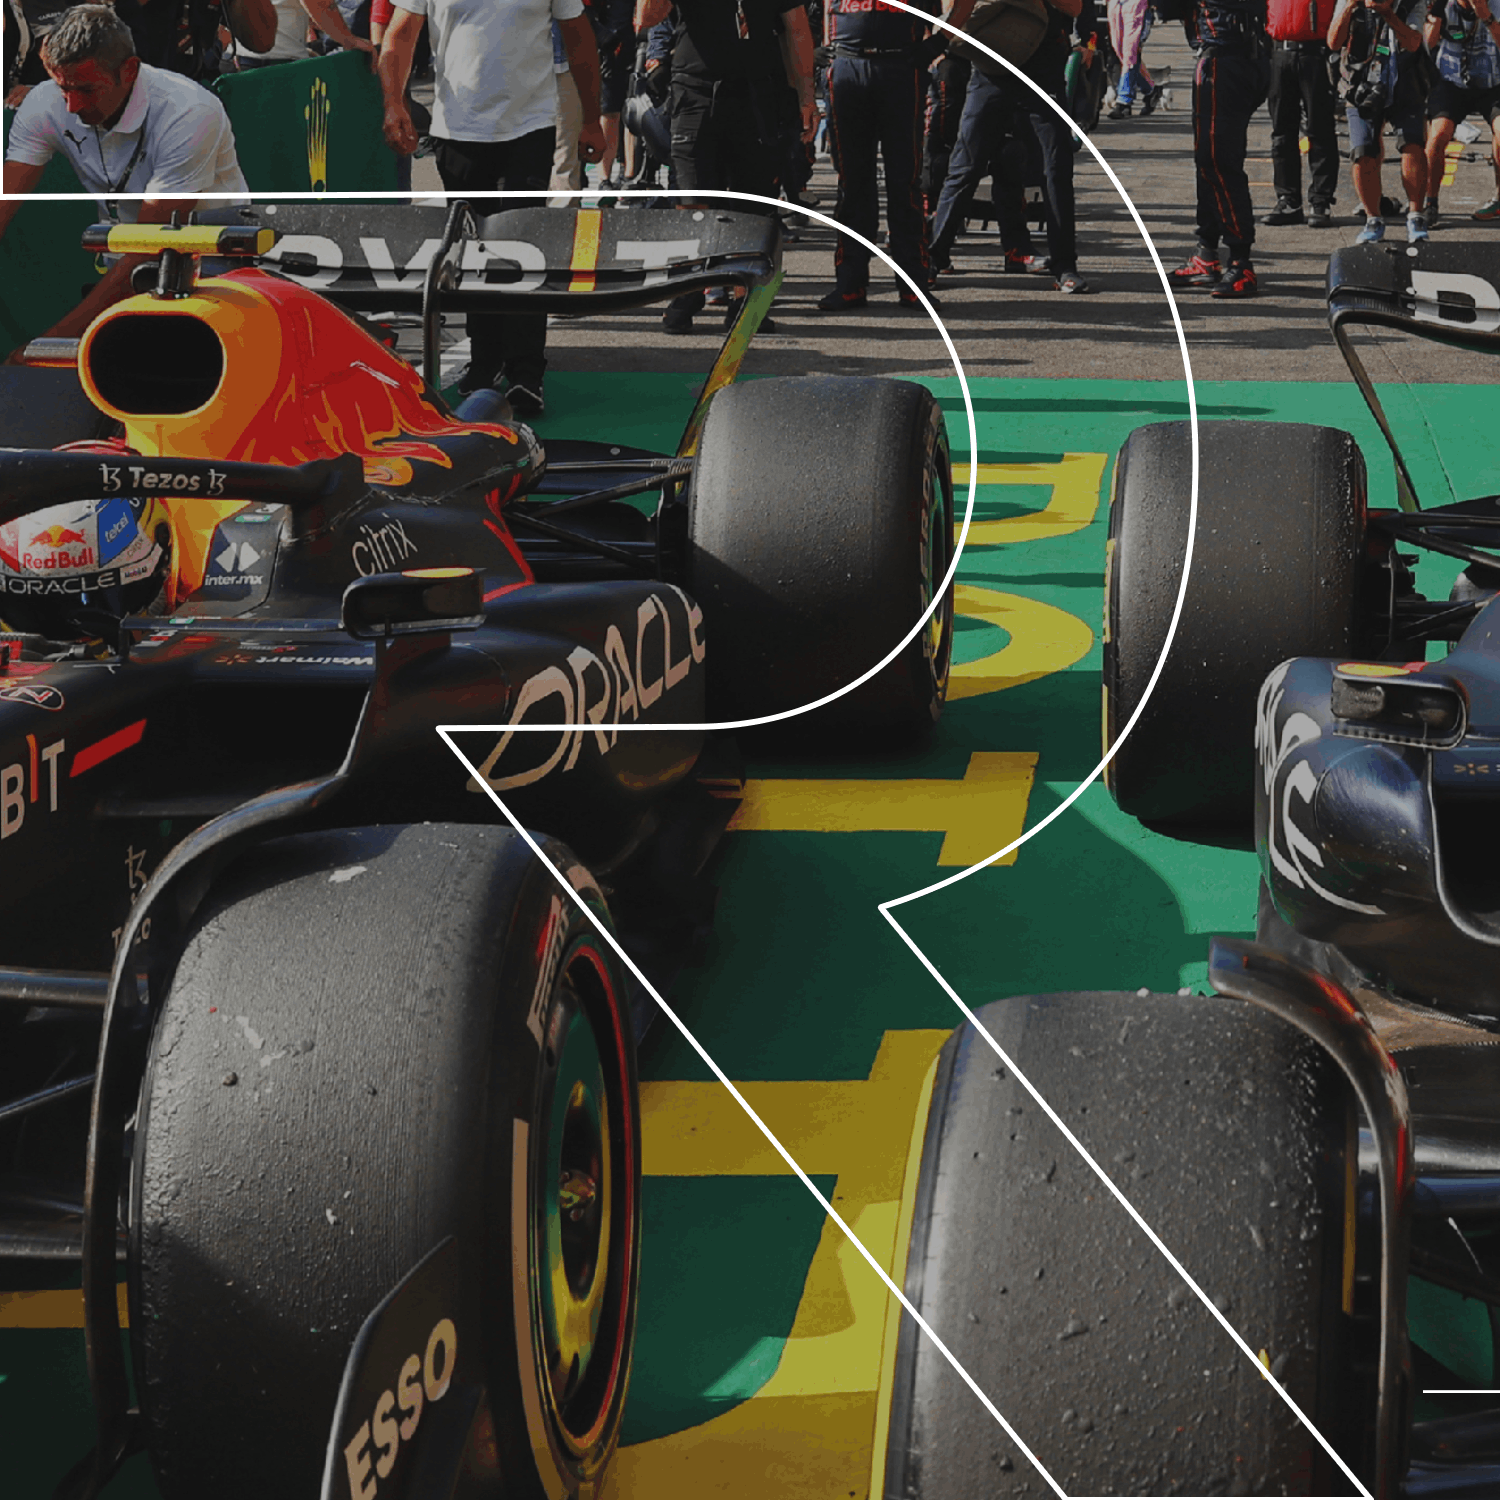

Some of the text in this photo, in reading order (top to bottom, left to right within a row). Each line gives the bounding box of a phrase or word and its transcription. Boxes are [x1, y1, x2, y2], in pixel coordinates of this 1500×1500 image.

[128, 466, 201, 492] Tezos
[104, 511, 130, 544] telcel
[23, 547, 95, 570] Red Bull
[351, 512, 418, 579] citrix
[8, 571, 116, 595] ORACLE
[205, 574, 264, 587] inter.mx
[466, 583, 706, 793] ORACLE
[343, 1317, 457, 1500] ESSO
